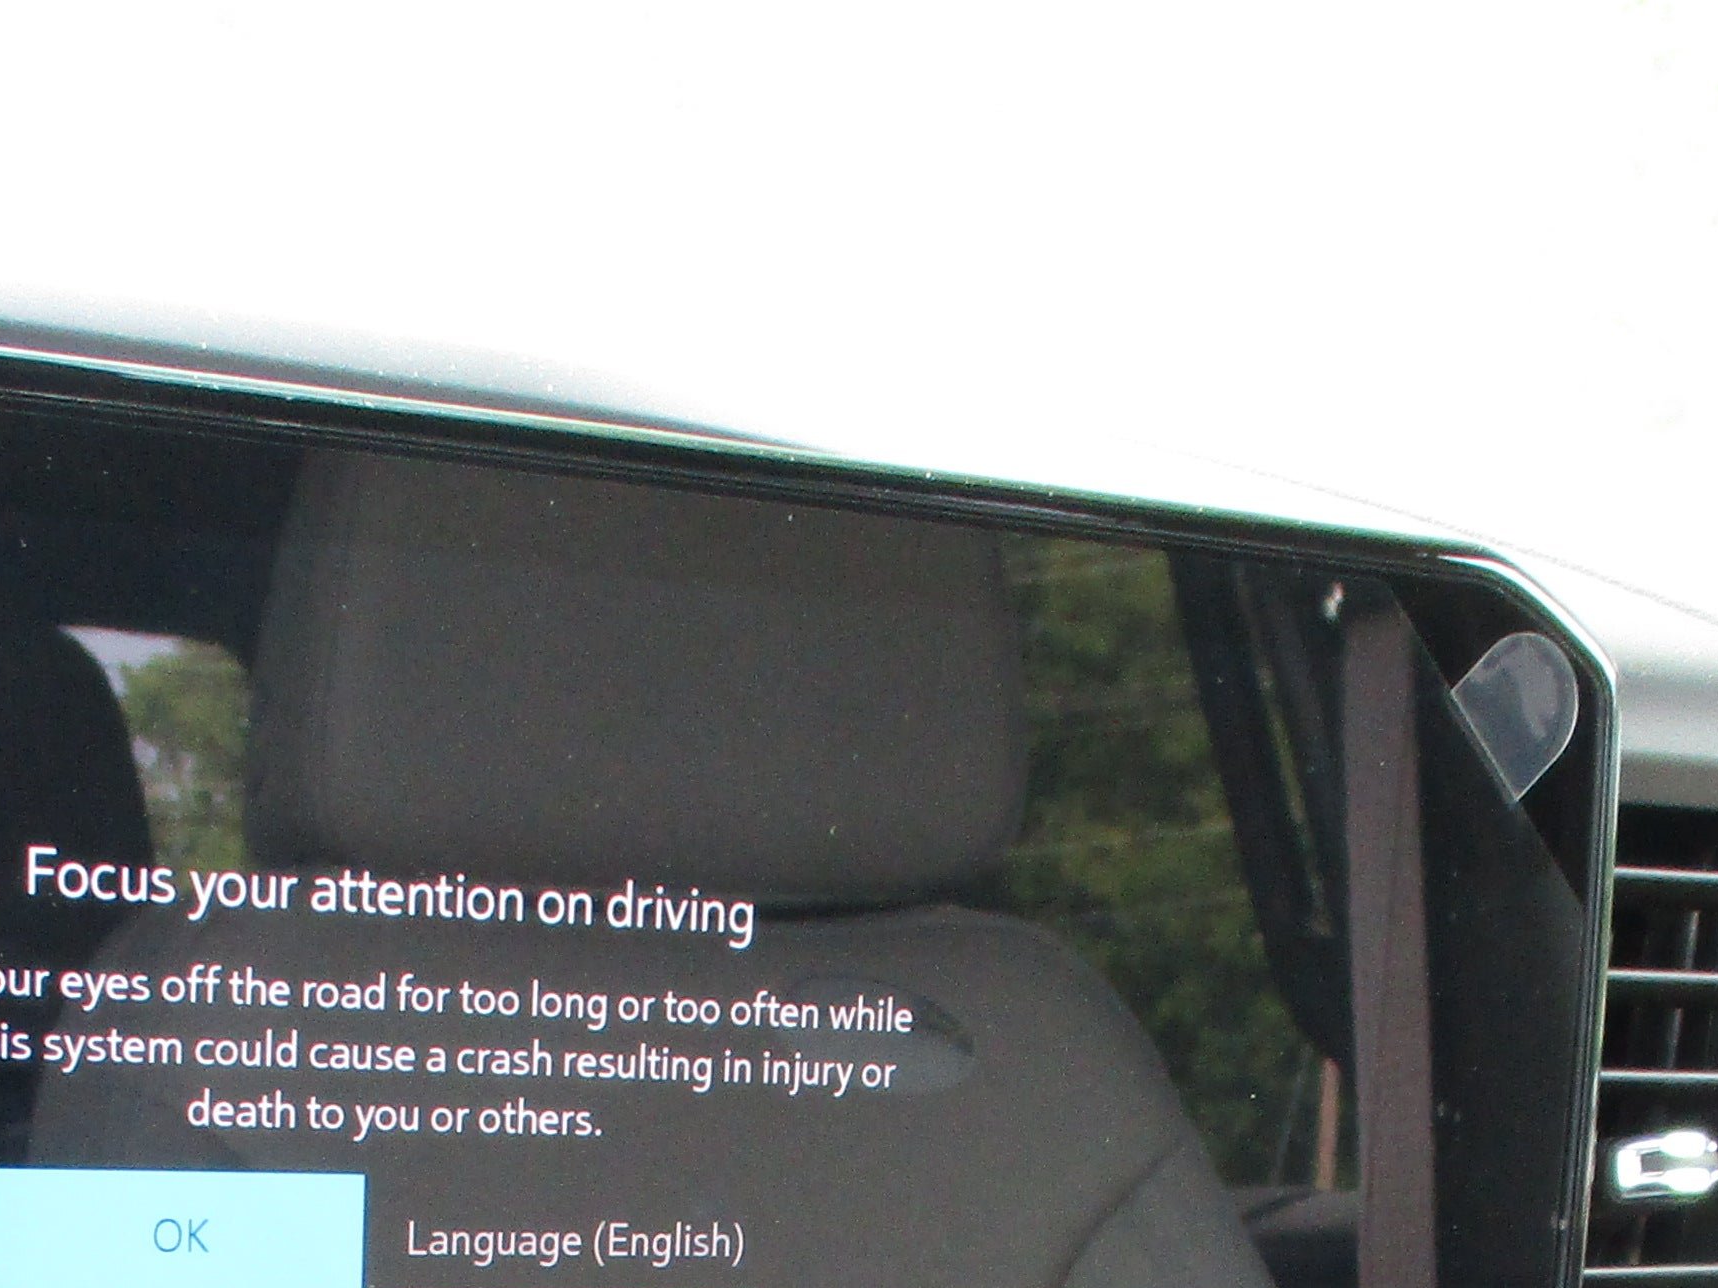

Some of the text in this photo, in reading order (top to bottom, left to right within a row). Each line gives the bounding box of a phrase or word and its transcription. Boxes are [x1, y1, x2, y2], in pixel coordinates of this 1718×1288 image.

[28, 846, 754, 950] Focus your attention on driving
[60, 972, 151, 1012] eyes
[161, 963, 222, 1004] off
[228, 966, 291, 1007] the
[302, 972, 386, 1011] road
[396, 973, 451, 1014] for
[459, 981, 520, 1016] too
[531, 979, 608, 1032] long
[617, 996, 656, 1022] or
[663, 990, 721, 1025] too
[730, 990, 819, 1030] often
[829, 994, 913, 1033] while
[43, 1028, 183, 1074] system
[194, 1028, 298, 1068] could
[309, 1043, 416, 1072] cause
[425, 1047, 447, 1073] a
[456, 1038, 553, 1077] crash
[563, 1042, 713, 1093] resulting
[723, 1049, 752, 1084] in
[762, 1051, 854, 1098] injury
[861, 1063, 897, 1089] or
[187, 1087, 602, 1142] death to you or others.
[152, 1218, 209, 1254] OK
[408, 1220, 744, 1268] Language (English)
